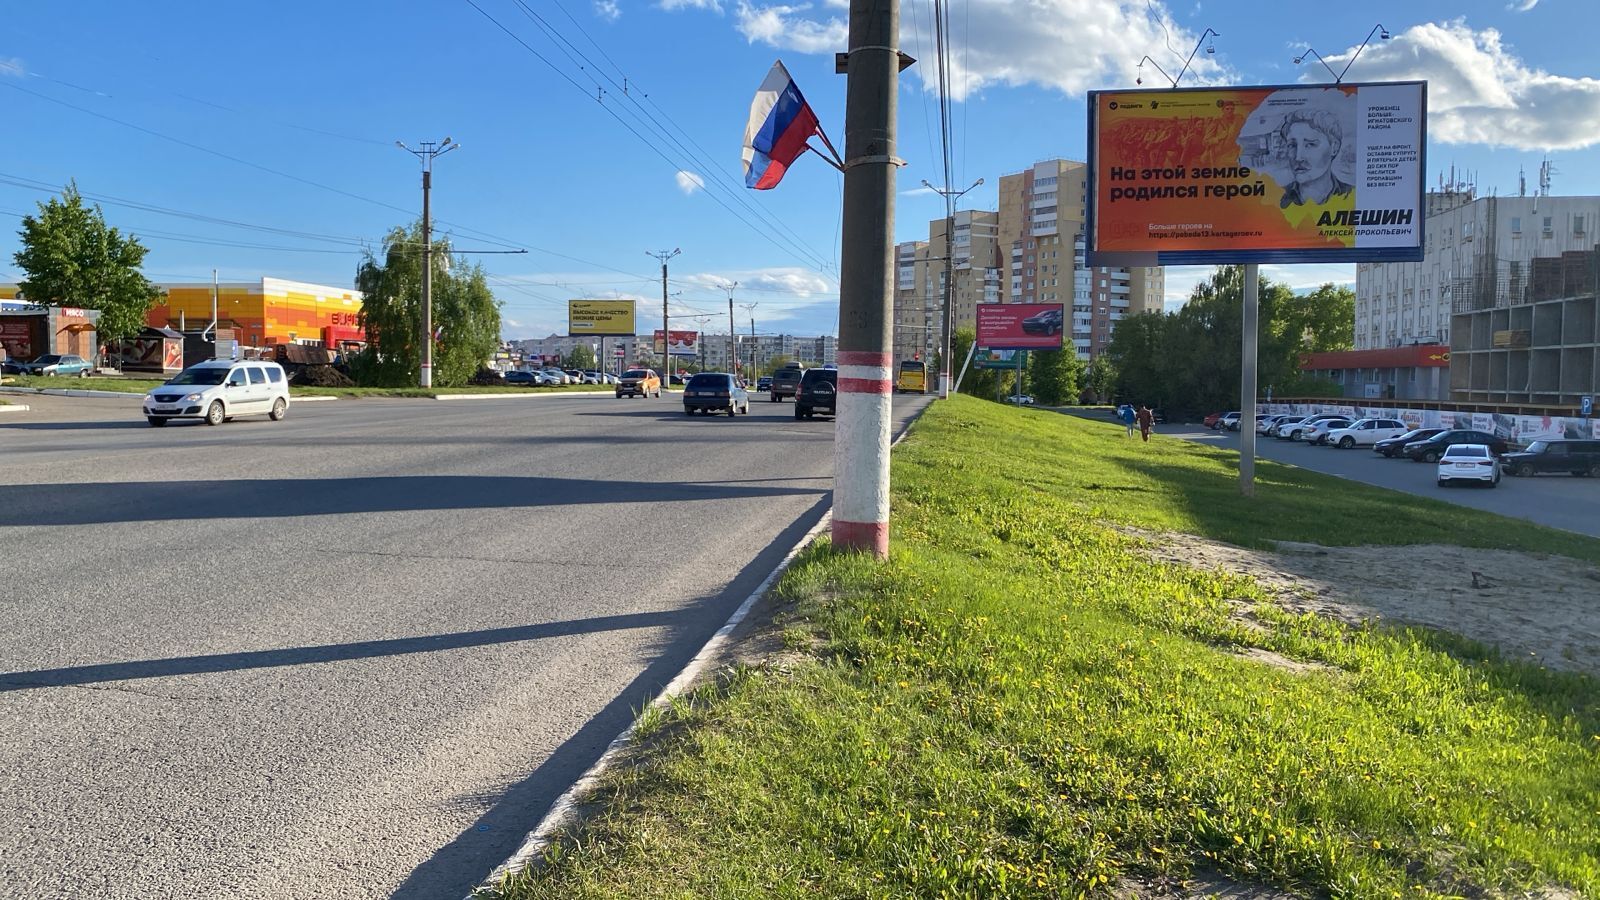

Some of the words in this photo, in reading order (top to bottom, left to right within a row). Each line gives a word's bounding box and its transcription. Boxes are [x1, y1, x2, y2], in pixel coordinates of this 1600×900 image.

[1110, 166, 1136, 180] На
[1141, 165, 1186, 180] этой
[1191, 166, 1250, 179] земле
[1110, 185, 1198, 202] родился
[1204, 181, 1265, 200] герой
[1316, 209, 1414, 226] АЛЕШИН
[1318, 228, 1353, 236] АЛЕКСЕЙ
[1354, 228, 1412, 236] ПРОКОПЬЕВИЧ
